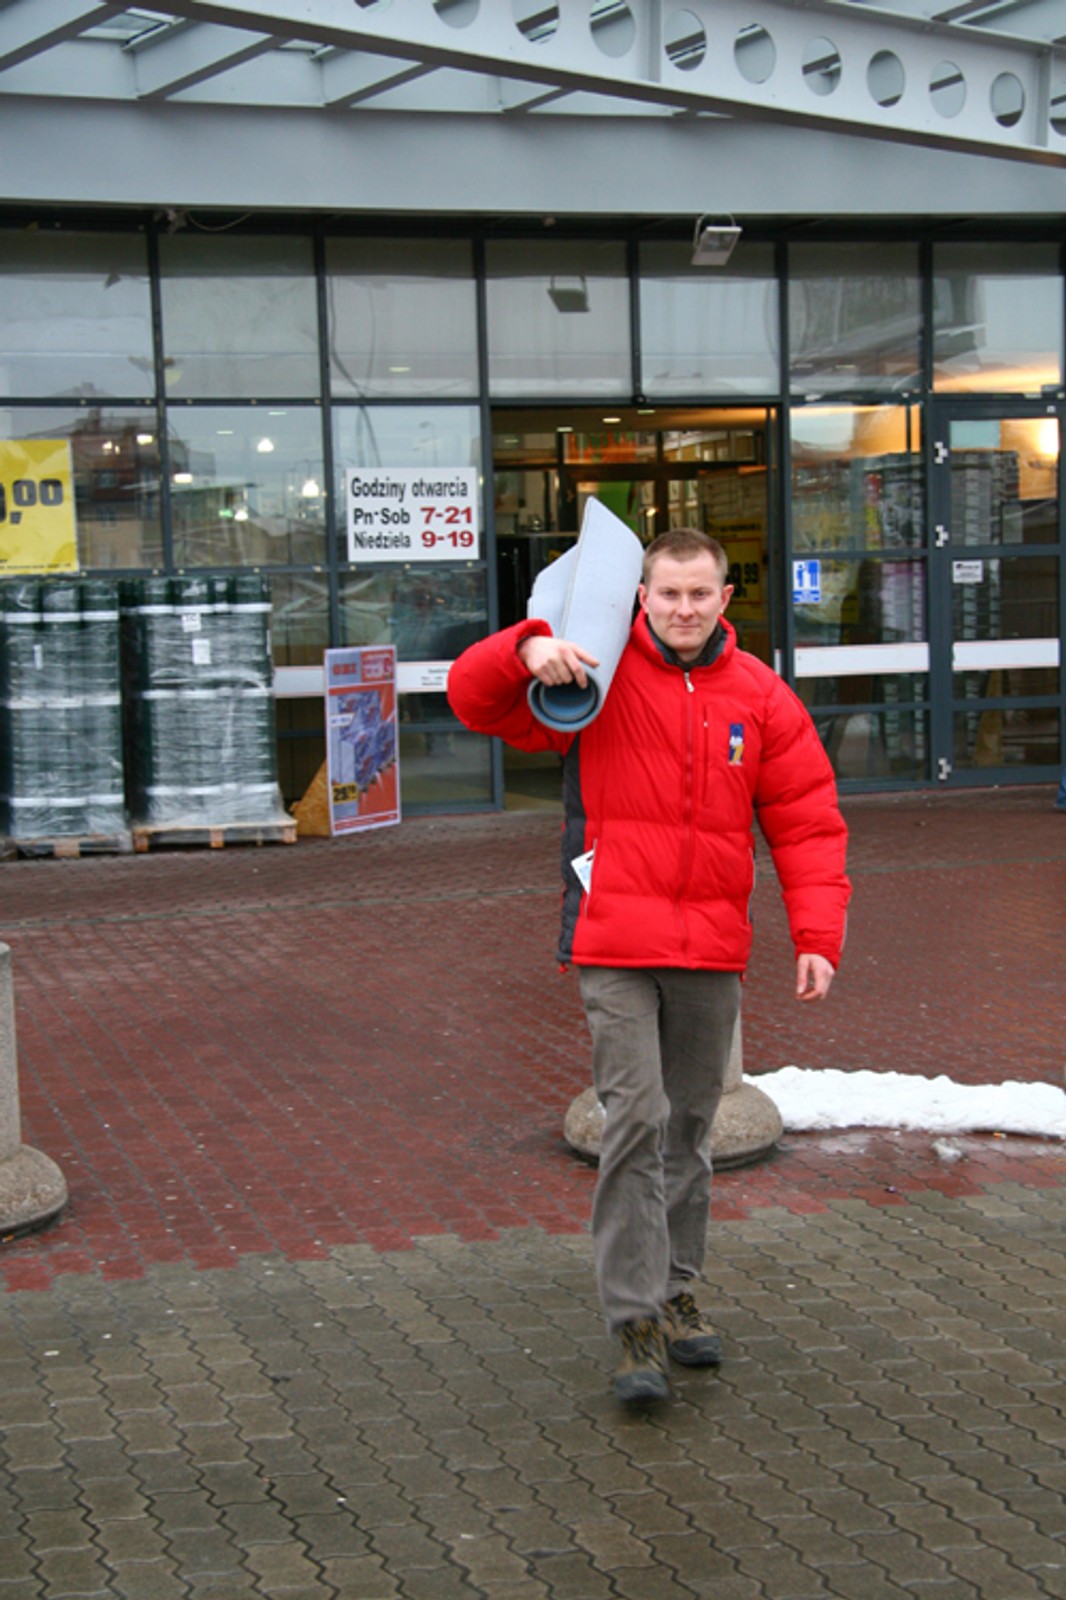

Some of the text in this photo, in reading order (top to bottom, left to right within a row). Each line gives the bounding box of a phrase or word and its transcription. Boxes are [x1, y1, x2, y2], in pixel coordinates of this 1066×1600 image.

[0, 478, 64, 524] ,00
[351, 476, 468, 503] Godziny otwarcia
[420, 506, 473, 525] 7-21
[354, 530, 474, 549] Niedziela 9-19
